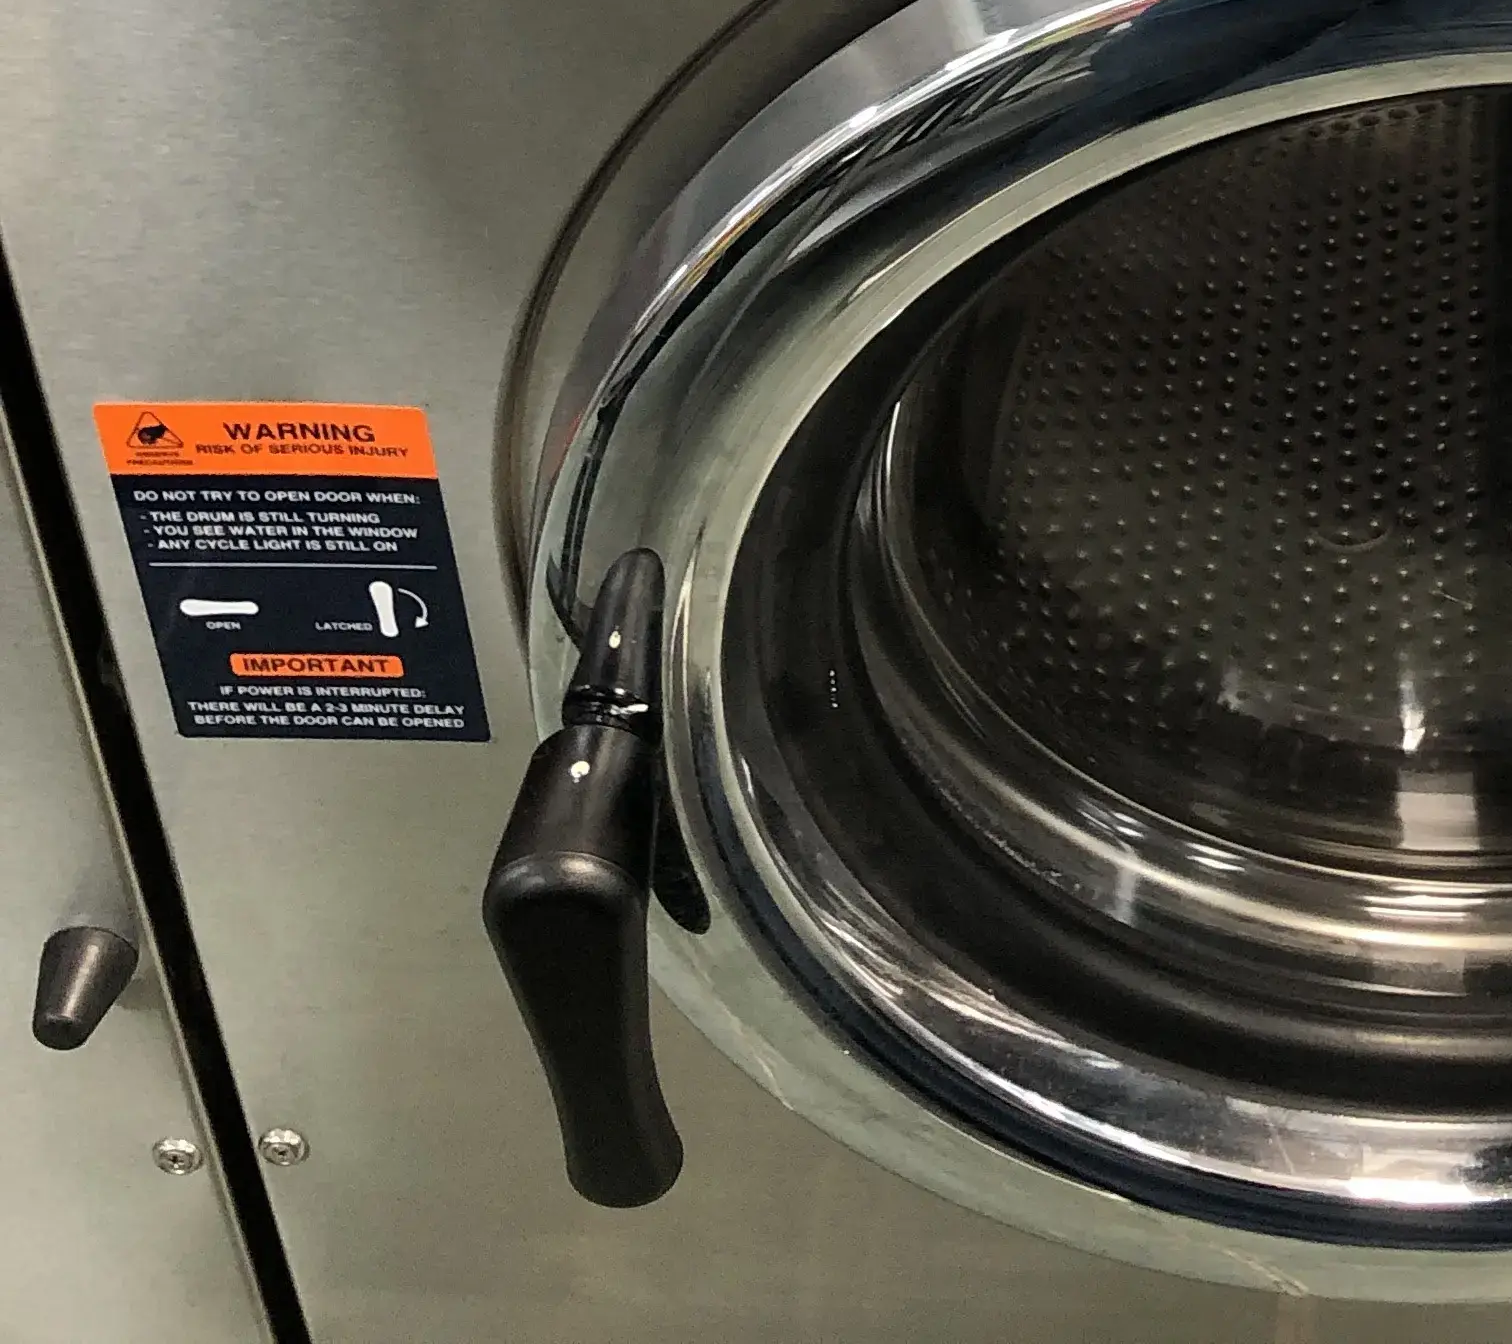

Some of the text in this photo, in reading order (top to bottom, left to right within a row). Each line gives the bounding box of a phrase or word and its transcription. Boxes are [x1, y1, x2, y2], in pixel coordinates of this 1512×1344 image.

[222, 422, 376, 443] WARNING
[195, 443, 409, 457] RISK OF SERIOUS INJURY
[133, 490, 421, 505] DO NOT TRY TO OPEN DOOR WHEN:
[149, 511, 381, 524] THE DRUM IS STILL TURNING
[153, 525, 418, 538] YOU SEE WATER IN THE WINDOW
[157, 539, 399, 552] ANY CYCLE LIGHT IS STILL ON
[205, 620, 242, 630] OPEN
[315, 621, 374, 631] LATCHED
[242, 658, 389, 673] IMPORTANT
[219, 685, 427, 699] IF POWER IS INTERRUPTED:
[187, 700, 465, 715] THERE WILL BE A 2-3 MINUTE DELAY
[193, 714, 465, 729] BEFORE THE DOOR CAN BE OPENED
